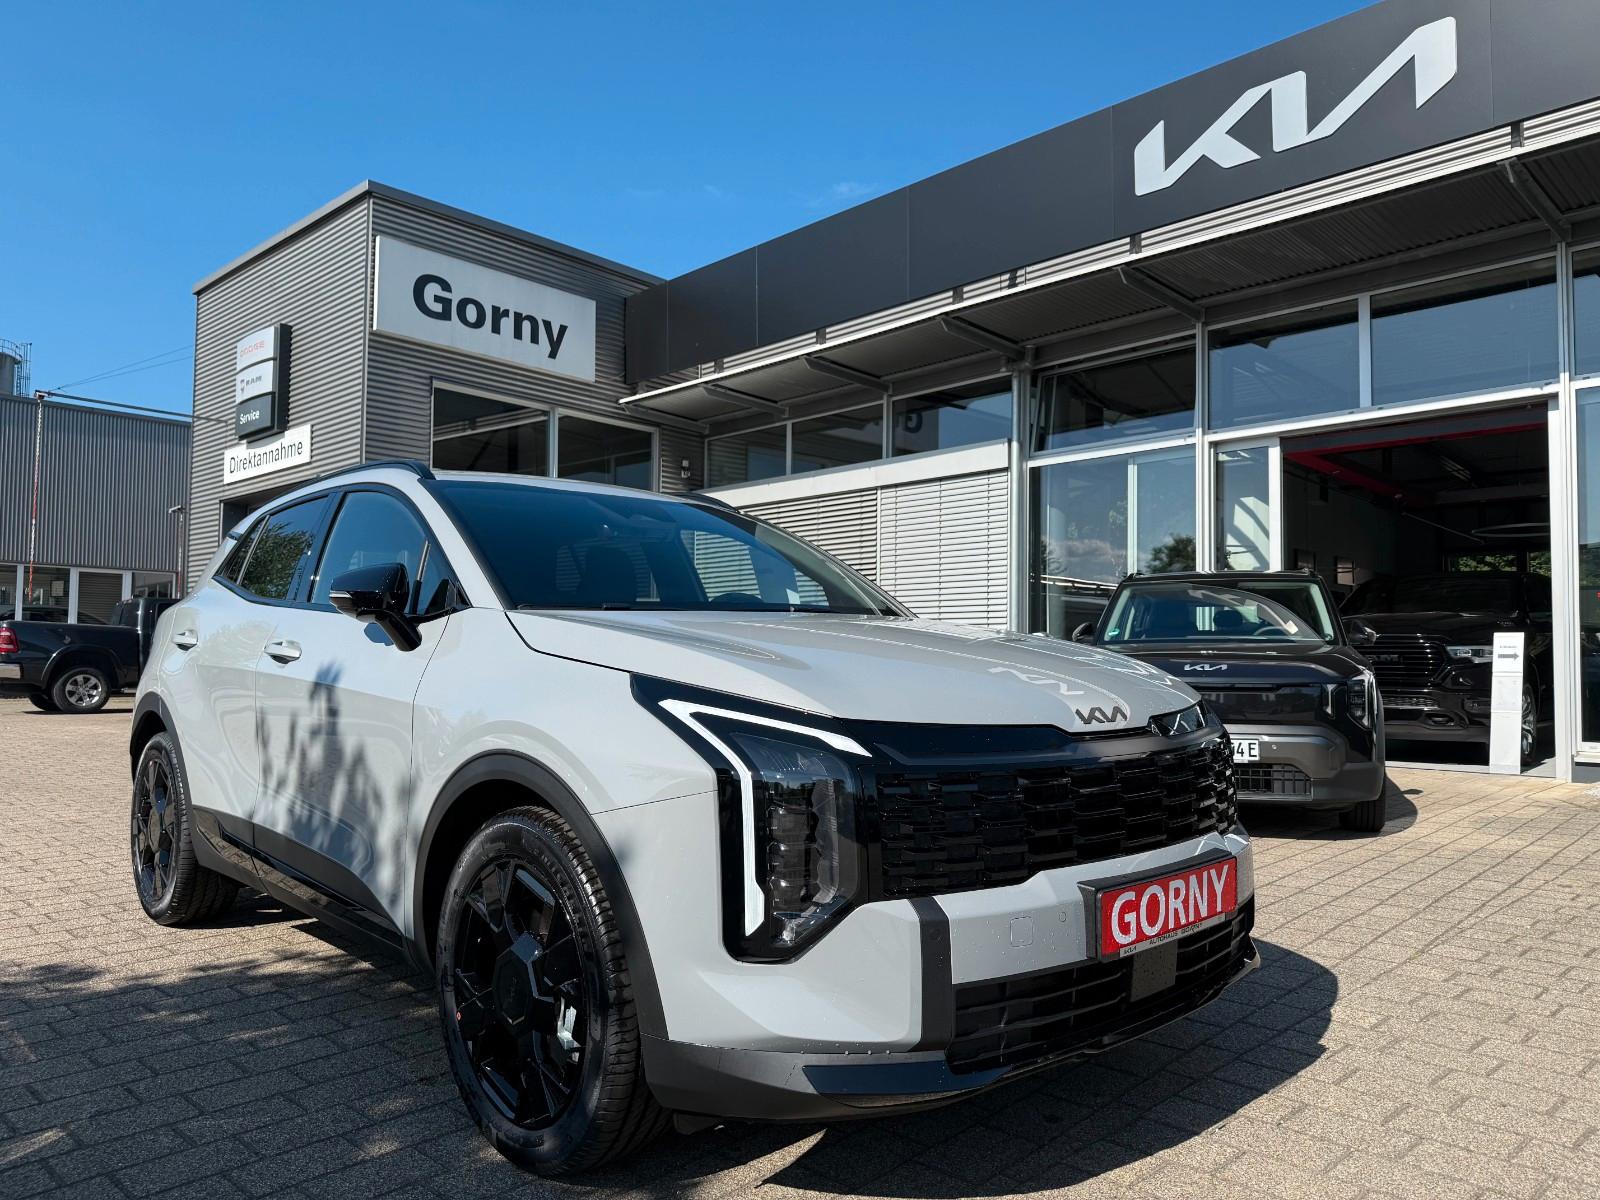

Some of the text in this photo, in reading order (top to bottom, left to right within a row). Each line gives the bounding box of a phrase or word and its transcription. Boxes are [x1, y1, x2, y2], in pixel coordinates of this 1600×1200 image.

[1134, 16, 1457, 196] KIA
[413, 274, 568, 360] Gorny
[239, 409, 260, 425] Service
[229, 441, 303, 474] Direktannahme
[1075, 706, 1128, 724] KIA
[1111, 865, 1229, 945] GORNY
